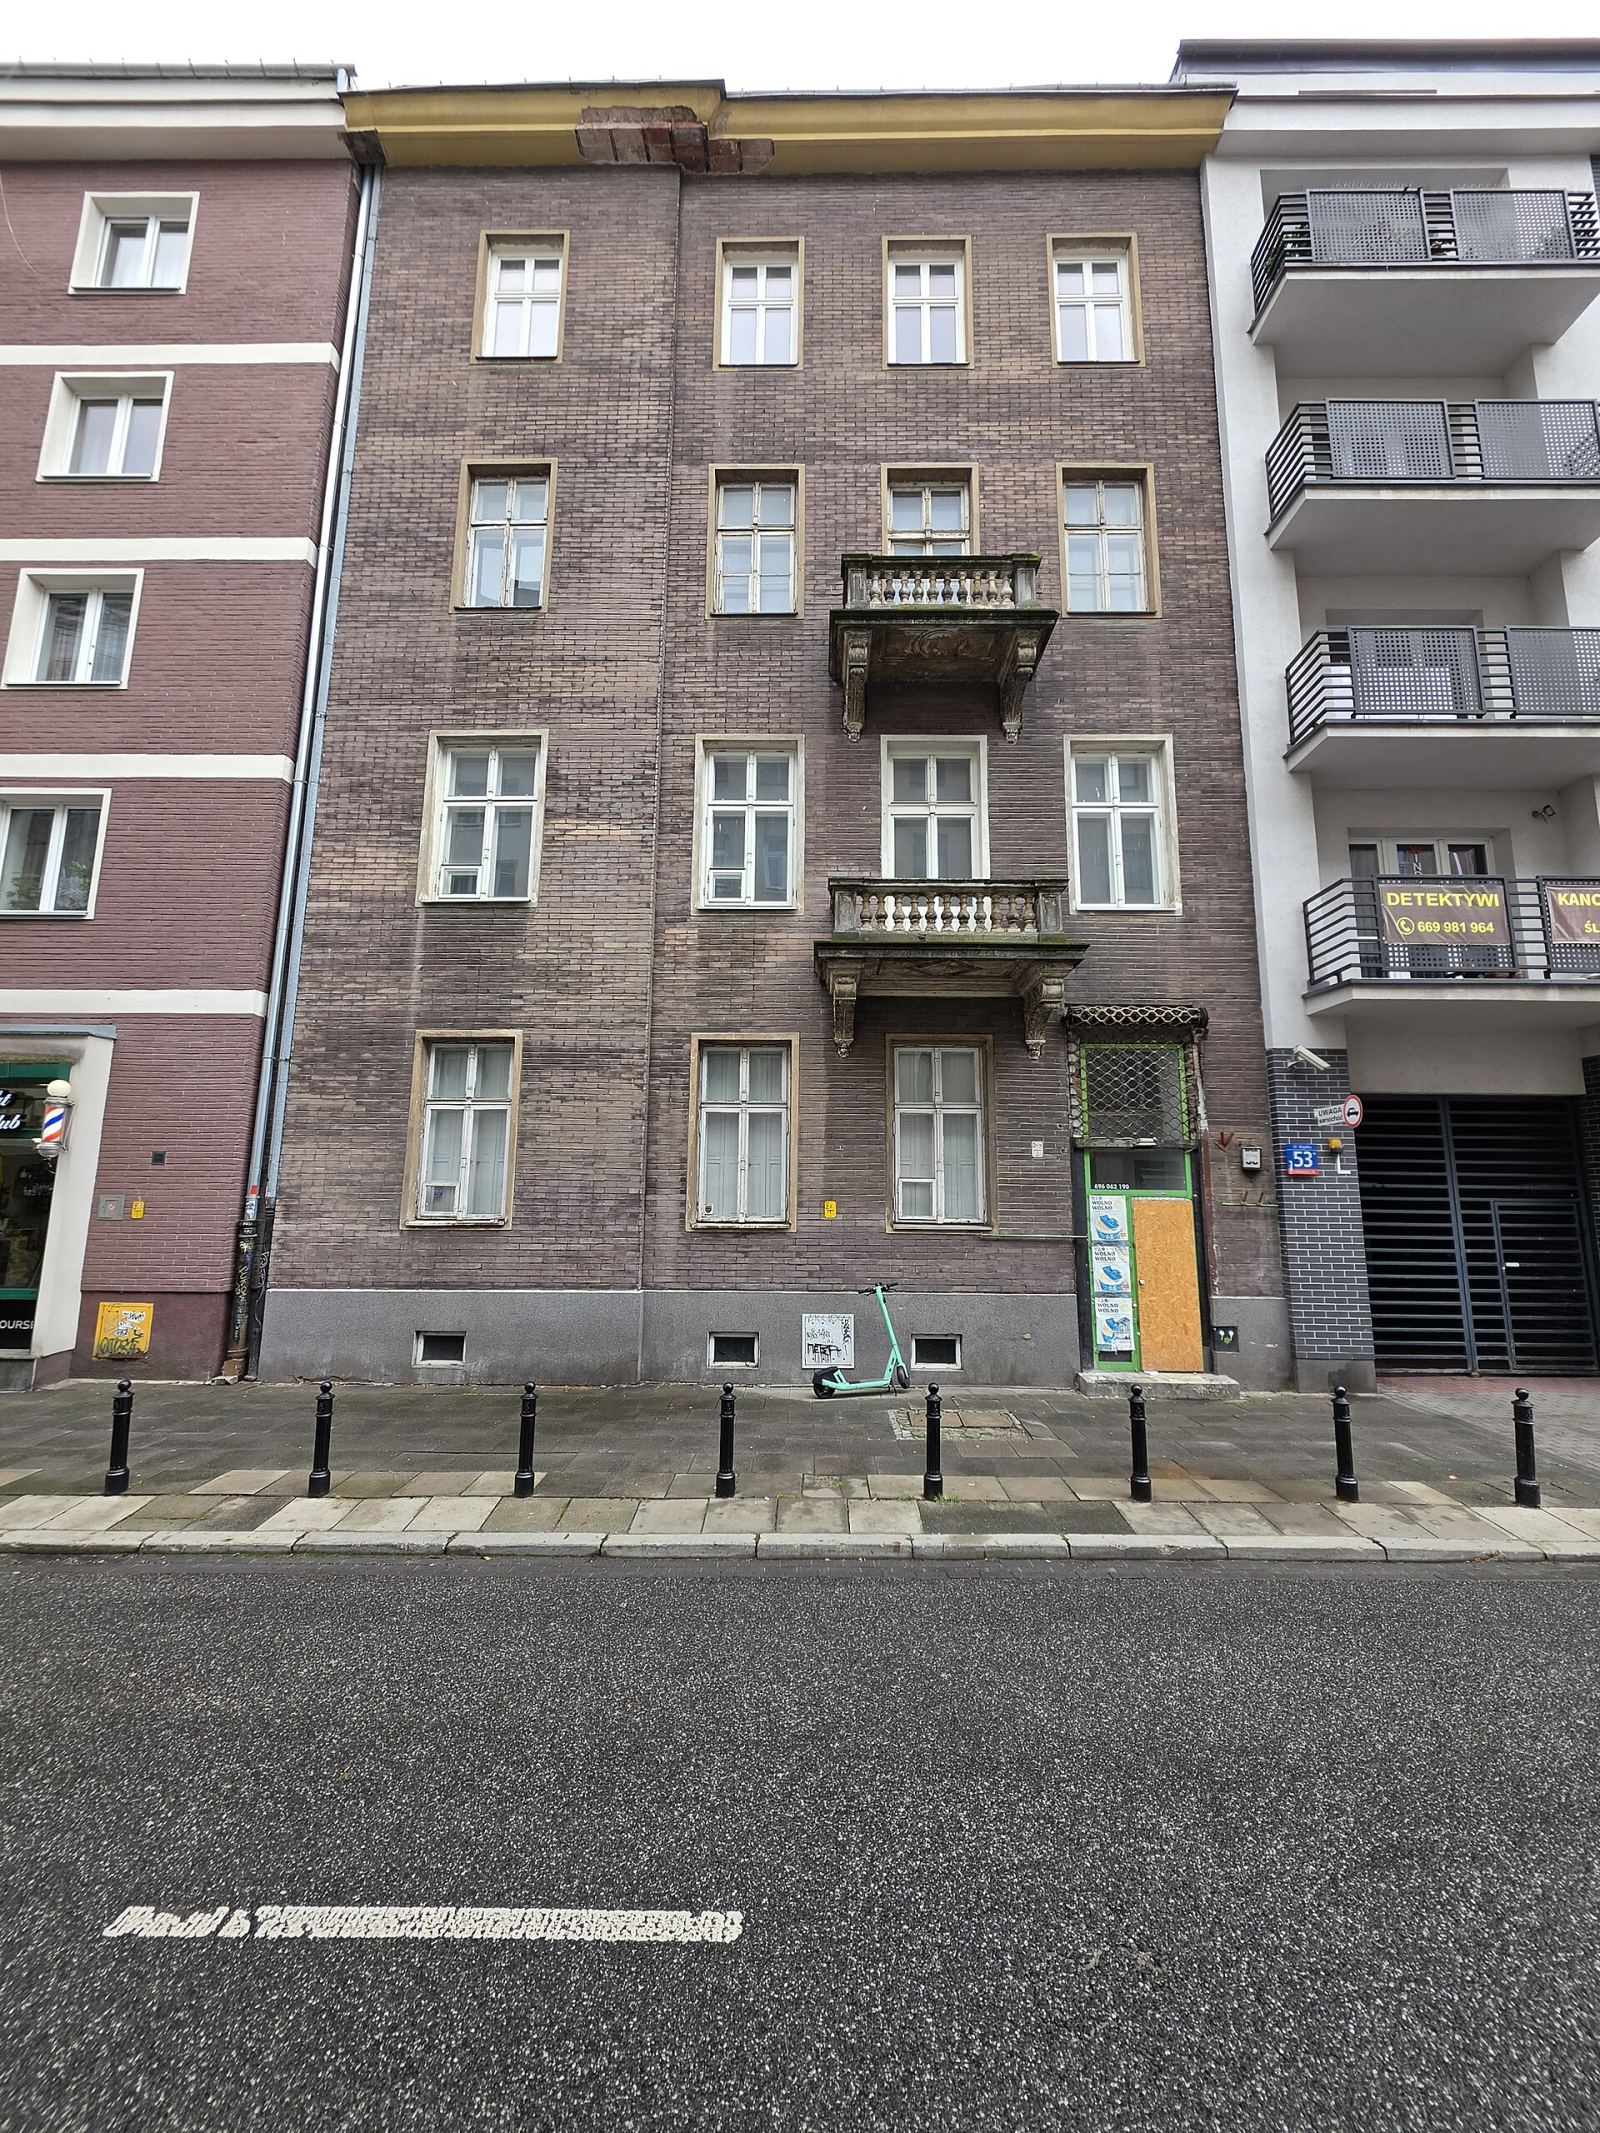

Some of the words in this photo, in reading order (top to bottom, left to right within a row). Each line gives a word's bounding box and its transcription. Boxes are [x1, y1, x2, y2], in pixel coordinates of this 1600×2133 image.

[1387, 893, 1500, 907] DETEKTYWI
[1418, 921, 1441, 933] 669
[1444, 921, 1466, 933] 981
[1471, 921, 1494, 933] 964
[1318, 1106, 1342, 1117] UWAGA
[1293, 1151, 1313, 1168] 53
